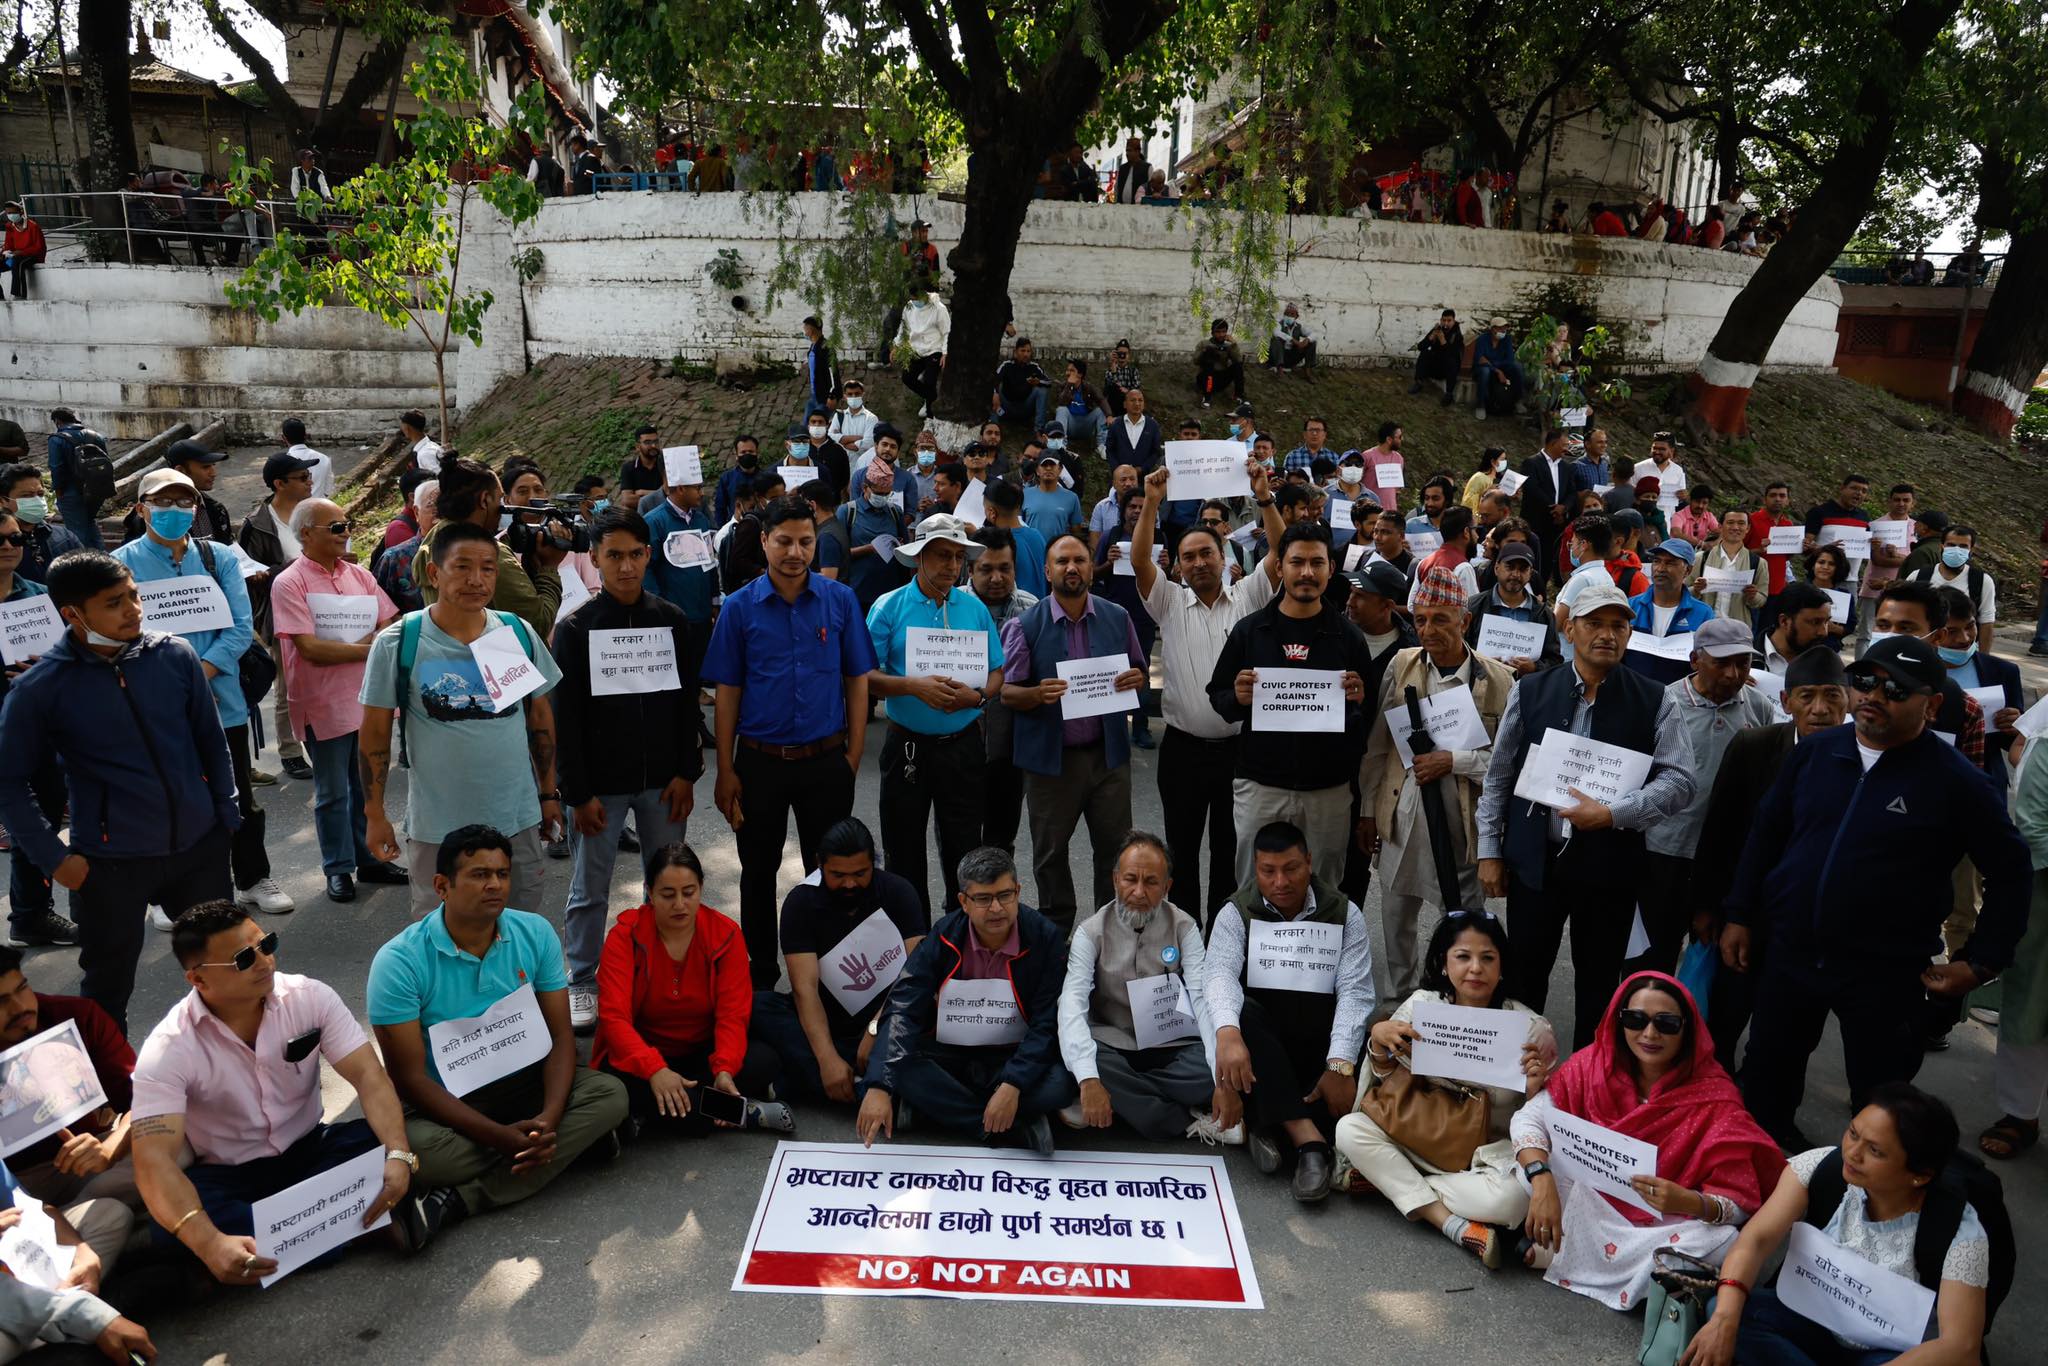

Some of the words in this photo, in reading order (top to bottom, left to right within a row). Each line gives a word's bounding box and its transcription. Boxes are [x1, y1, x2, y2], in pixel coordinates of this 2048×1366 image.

[140, 591, 167, 602] CIVIC
[169, 586, 212, 598] PROTEST
[158, 597, 201, 609] AGAINST
[147, 606, 209, 622] CORRUPTION
[612, 635, 644, 645] सरकार
[927, 634, 954, 643] सरकार
[1076, 678, 1109, 687] CORRUPTION
[1273, 928, 1305, 938] सरकार
[946, 997, 965, 1007] कति
[987, 1000, 1017, 1008] भ्रष्टाचा
[946, 1013, 983, 1025] भ्रष्टाचारी
[441, 1038, 460, 1054] कति
[484, 1011, 525, 1035] भ्रष्टाचार
[1422, 1021, 1448, 1030] STAND
[1463, 1027, 1499, 1037] AGAINST
[1421, 1037, 1448, 1047] STAND
[1435, 1031, 1487, 1044] CORRUPTION
[446, 1045, 488, 1072] भ्रष्टाचारी
[490, 1030, 527, 1052] खबरदार
[1453, 1051, 1486, 1061] JUSTICE
[1553, 1124, 1582, 1143] CIVIC
[1585, 1138, 1638, 1167] PROTEST
[1573, 1144, 1619, 1172] AGAINST
[1562, 1147, 1632, 1188] CORRUPTION
[786, 1167, 883, 1189] भ्रष्टाचार
[888, 1169, 984, 1193] ढाकछोप
[1058, 1178, 1108, 1200] वृहत
[1115, 1176, 1208, 1200] नागरिक
[270, 1198, 327, 1235] भ्रष्टाचारी
[807, 1204, 933, 1230] आन्दोलमा
[938, 1208, 994, 1234] हाम्रो
[1002, 1211, 1042, 1239] पुर्ण
[1050, 1213, 1132, 1238] समर्थन
[1141, 1220, 1166, 1240] छ
[272, 1220, 327, 1255] लोकतन्त्र
[857, 1259, 920, 1283] NO,
[932, 1262, 1006, 1284] NOT
[1016, 1265, 1131, 1289] AGAIN
[1858, 1303, 1888, 1329] पेटमा
